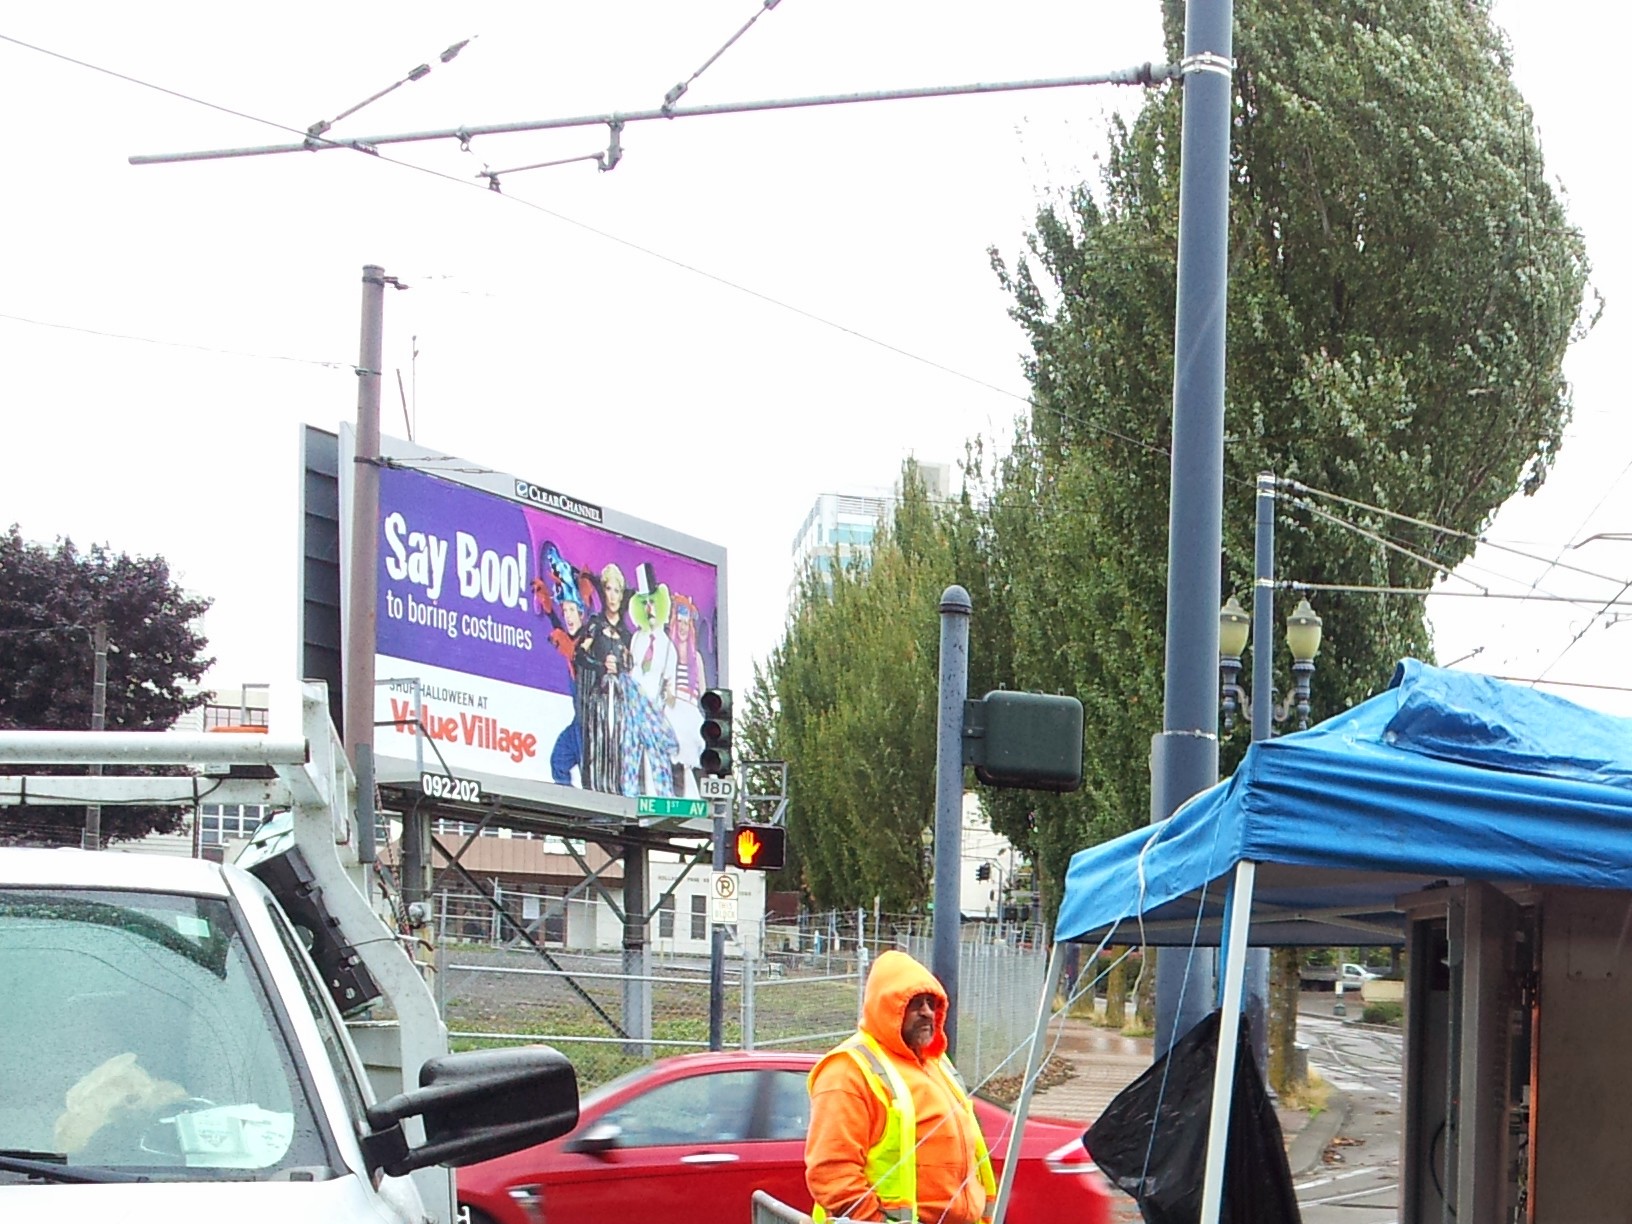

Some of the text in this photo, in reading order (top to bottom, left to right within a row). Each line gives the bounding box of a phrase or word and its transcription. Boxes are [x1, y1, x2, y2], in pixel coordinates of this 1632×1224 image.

[384, 512, 529, 612] Say Boo!
[386, 589, 533, 650] to boring costumes
[419, 684, 474, 707] HALLOWEEN
[477, 696, 488, 710] AT
[459, 712, 537, 763] Village
[422, 774, 480, 803] 092202
[703, 781, 732, 795] 18D
[640, 800, 656, 812] NE
[689, 802, 706, 816] AV
